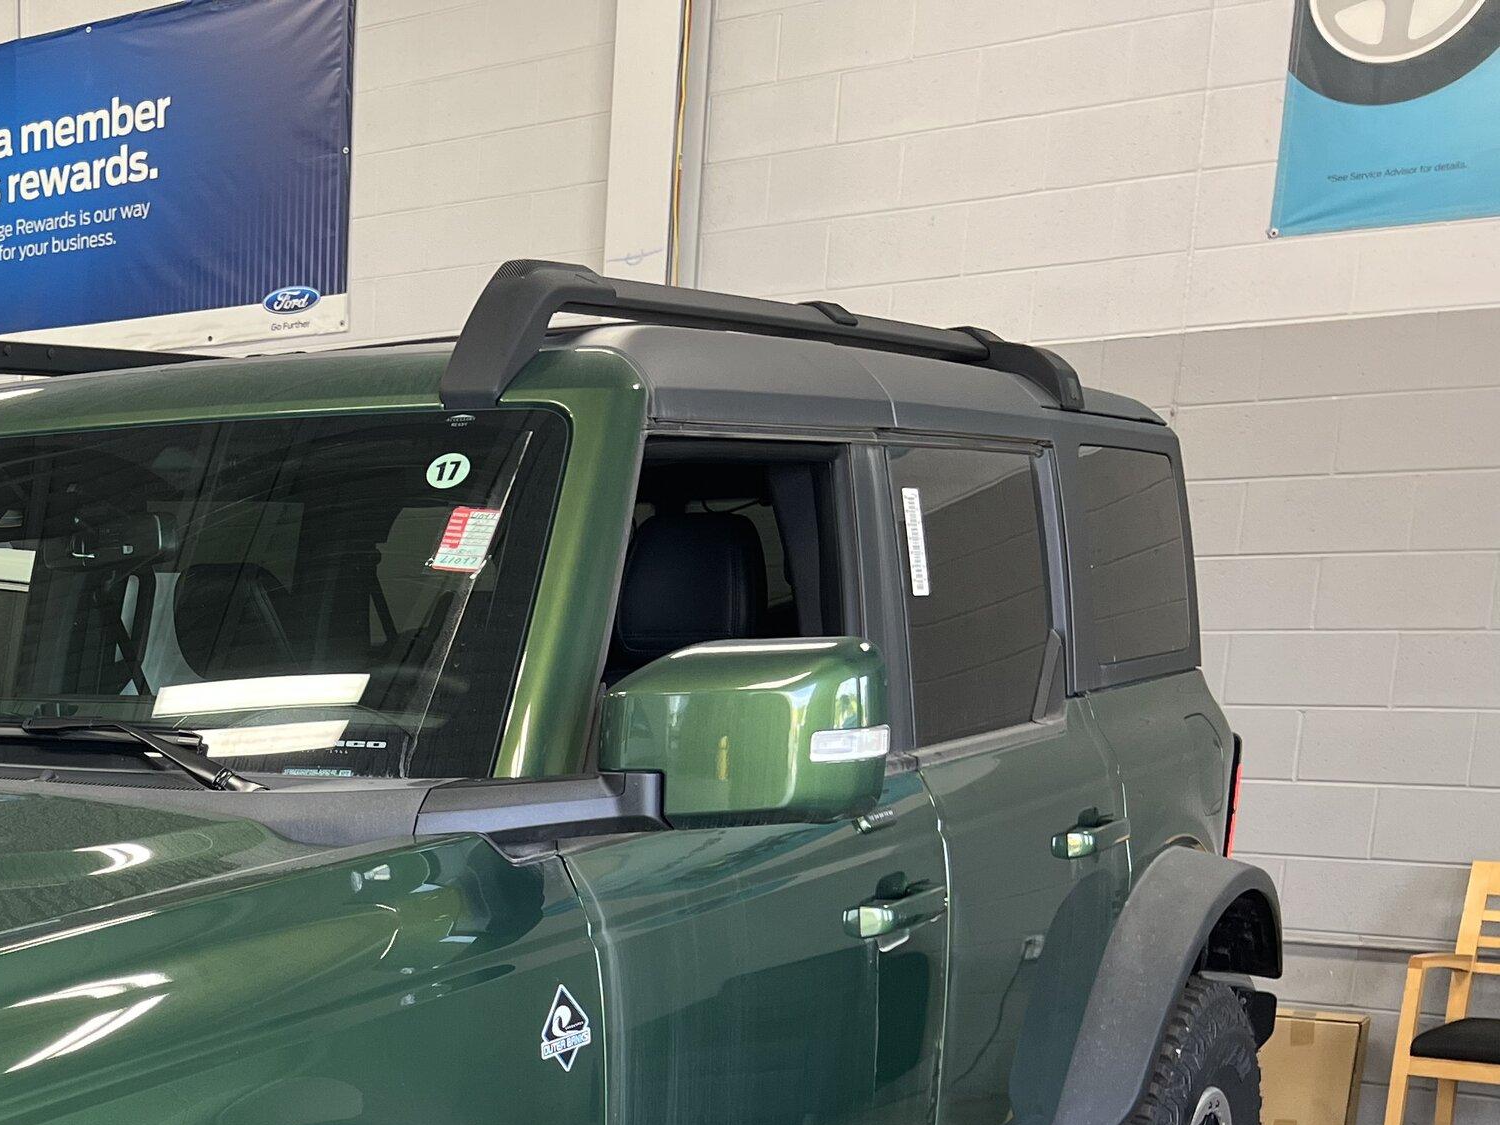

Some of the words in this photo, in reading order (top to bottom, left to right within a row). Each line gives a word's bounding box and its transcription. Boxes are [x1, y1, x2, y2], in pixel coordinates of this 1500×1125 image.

[21, 96, 171, 154] member
[8, 144, 158, 203] rewards.
[1350, 171, 1382, 181] Service
[1384, 167, 1417, 178] Advisor
[1419, 165, 1430, 173] for
[1434, 160, 1468, 172] details.
[15, 210, 76, 236] Rewards
[79, 209, 90, 226] is
[93, 206, 116, 223] our
[119, 201, 150, 221] way
[18, 241, 49, 262] your
[51, 231, 116, 255] business.
[271, 323, 282, 331] Go
[283, 320, 310, 331] Further
[436, 460, 462, 482] 17
[543, 1038, 566, 1056] OUTER
[565, 1031, 589, 1048] BANKS
